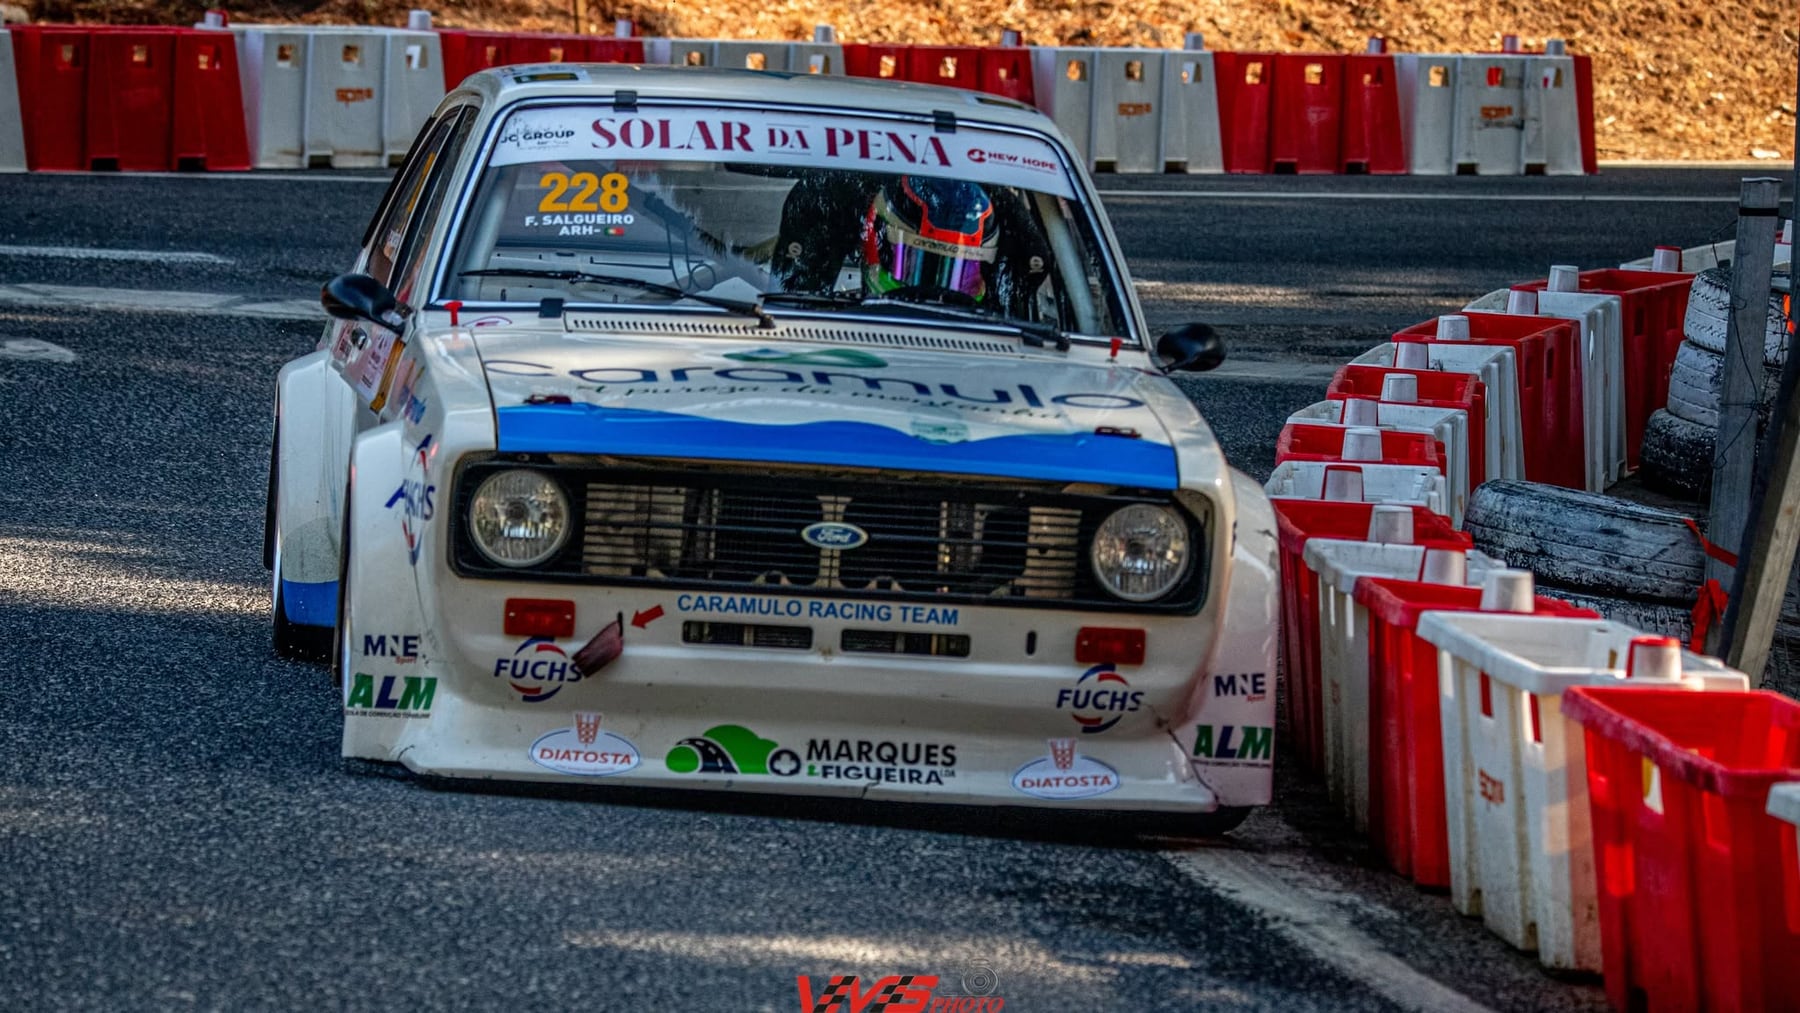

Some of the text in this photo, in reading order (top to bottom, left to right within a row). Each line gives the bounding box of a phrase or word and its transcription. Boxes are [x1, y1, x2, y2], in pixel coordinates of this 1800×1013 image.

[523, 130, 575, 140] GROUP
[591, 118, 952, 167] SOLAR DA PENA
[988, 151, 1018, 162] NEW
[1022, 156, 1057, 170] HOPE
[538, 172, 629, 213] 228
[525, 213, 635, 227] F. SALGUEIRO
[484, 359, 1145, 409] caramulo
[677, 594, 959, 626] CARAMULO RACING TEAM
[494, 658, 583, 682] FUCHS
[346, 672, 438, 711] ALM
[1056, 688, 1145, 712] FUCHS
[806, 738, 957, 768] MARQUES
[1193, 724, 1274, 761] ALM
[540, 748, 632, 765] DIATOSTA
[821, 765, 944, 785] FIGUEIRA
[1021, 775, 1111, 789] DIATOSTA
